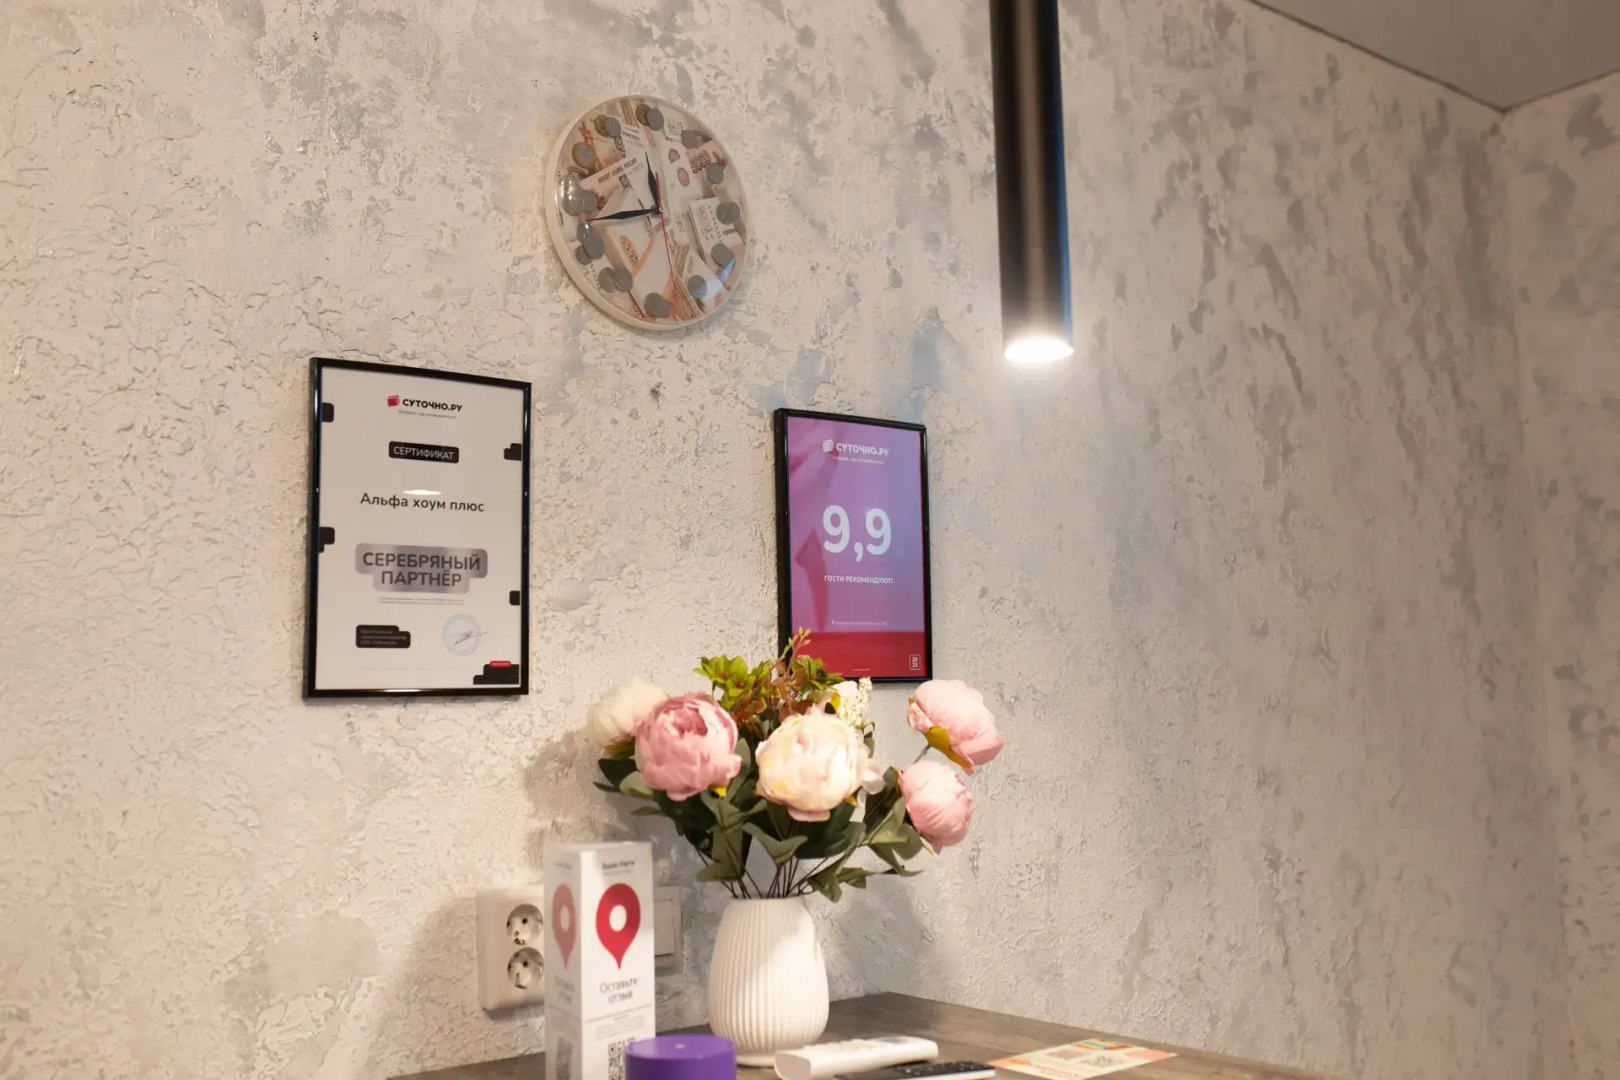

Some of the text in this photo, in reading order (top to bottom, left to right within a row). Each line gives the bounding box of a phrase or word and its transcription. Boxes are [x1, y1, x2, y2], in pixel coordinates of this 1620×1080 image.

[402, 398, 463, 412] СУТОЧНО.РУ
[393, 446, 455, 460] СЕРТИФИКАТ
[836, 442, 890, 456] СУТОЧНО.РУ
[360, 493, 485, 512] Альфа хоум плюс
[822, 505, 892, 562] 9,9
[362, 552, 481, 571] СЕРЕБРЯНЫЙ
[381, 569, 462, 587] ПАРТНЁР
[824, 575, 845, 583] ГОСТИ
